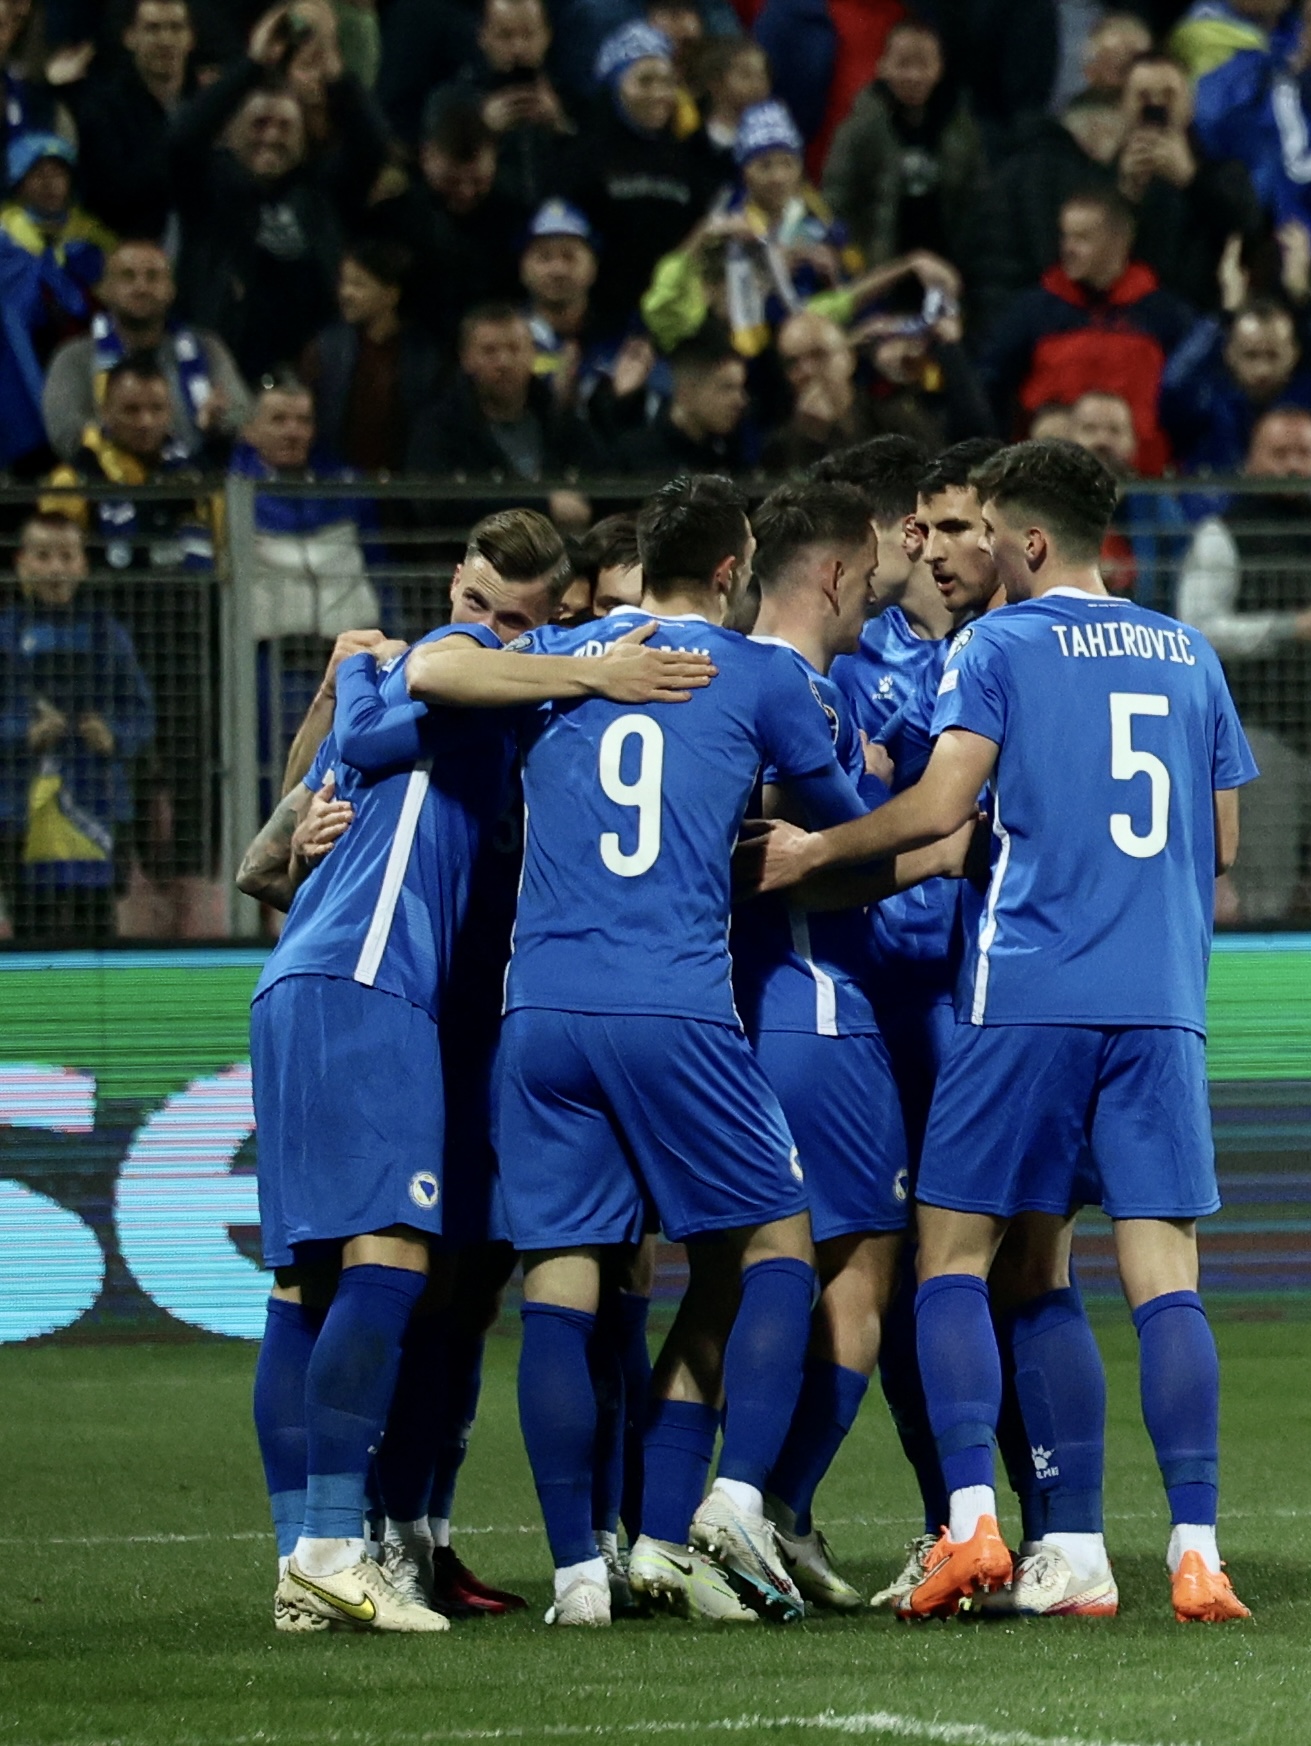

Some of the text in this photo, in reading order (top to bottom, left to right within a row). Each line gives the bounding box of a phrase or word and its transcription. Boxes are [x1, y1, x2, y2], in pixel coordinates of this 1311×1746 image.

[1051, 621, 1196, 666] TAHIROVIĆ
[600, 714, 664, 877] 9
[1108, 692, 1170, 858] 5
